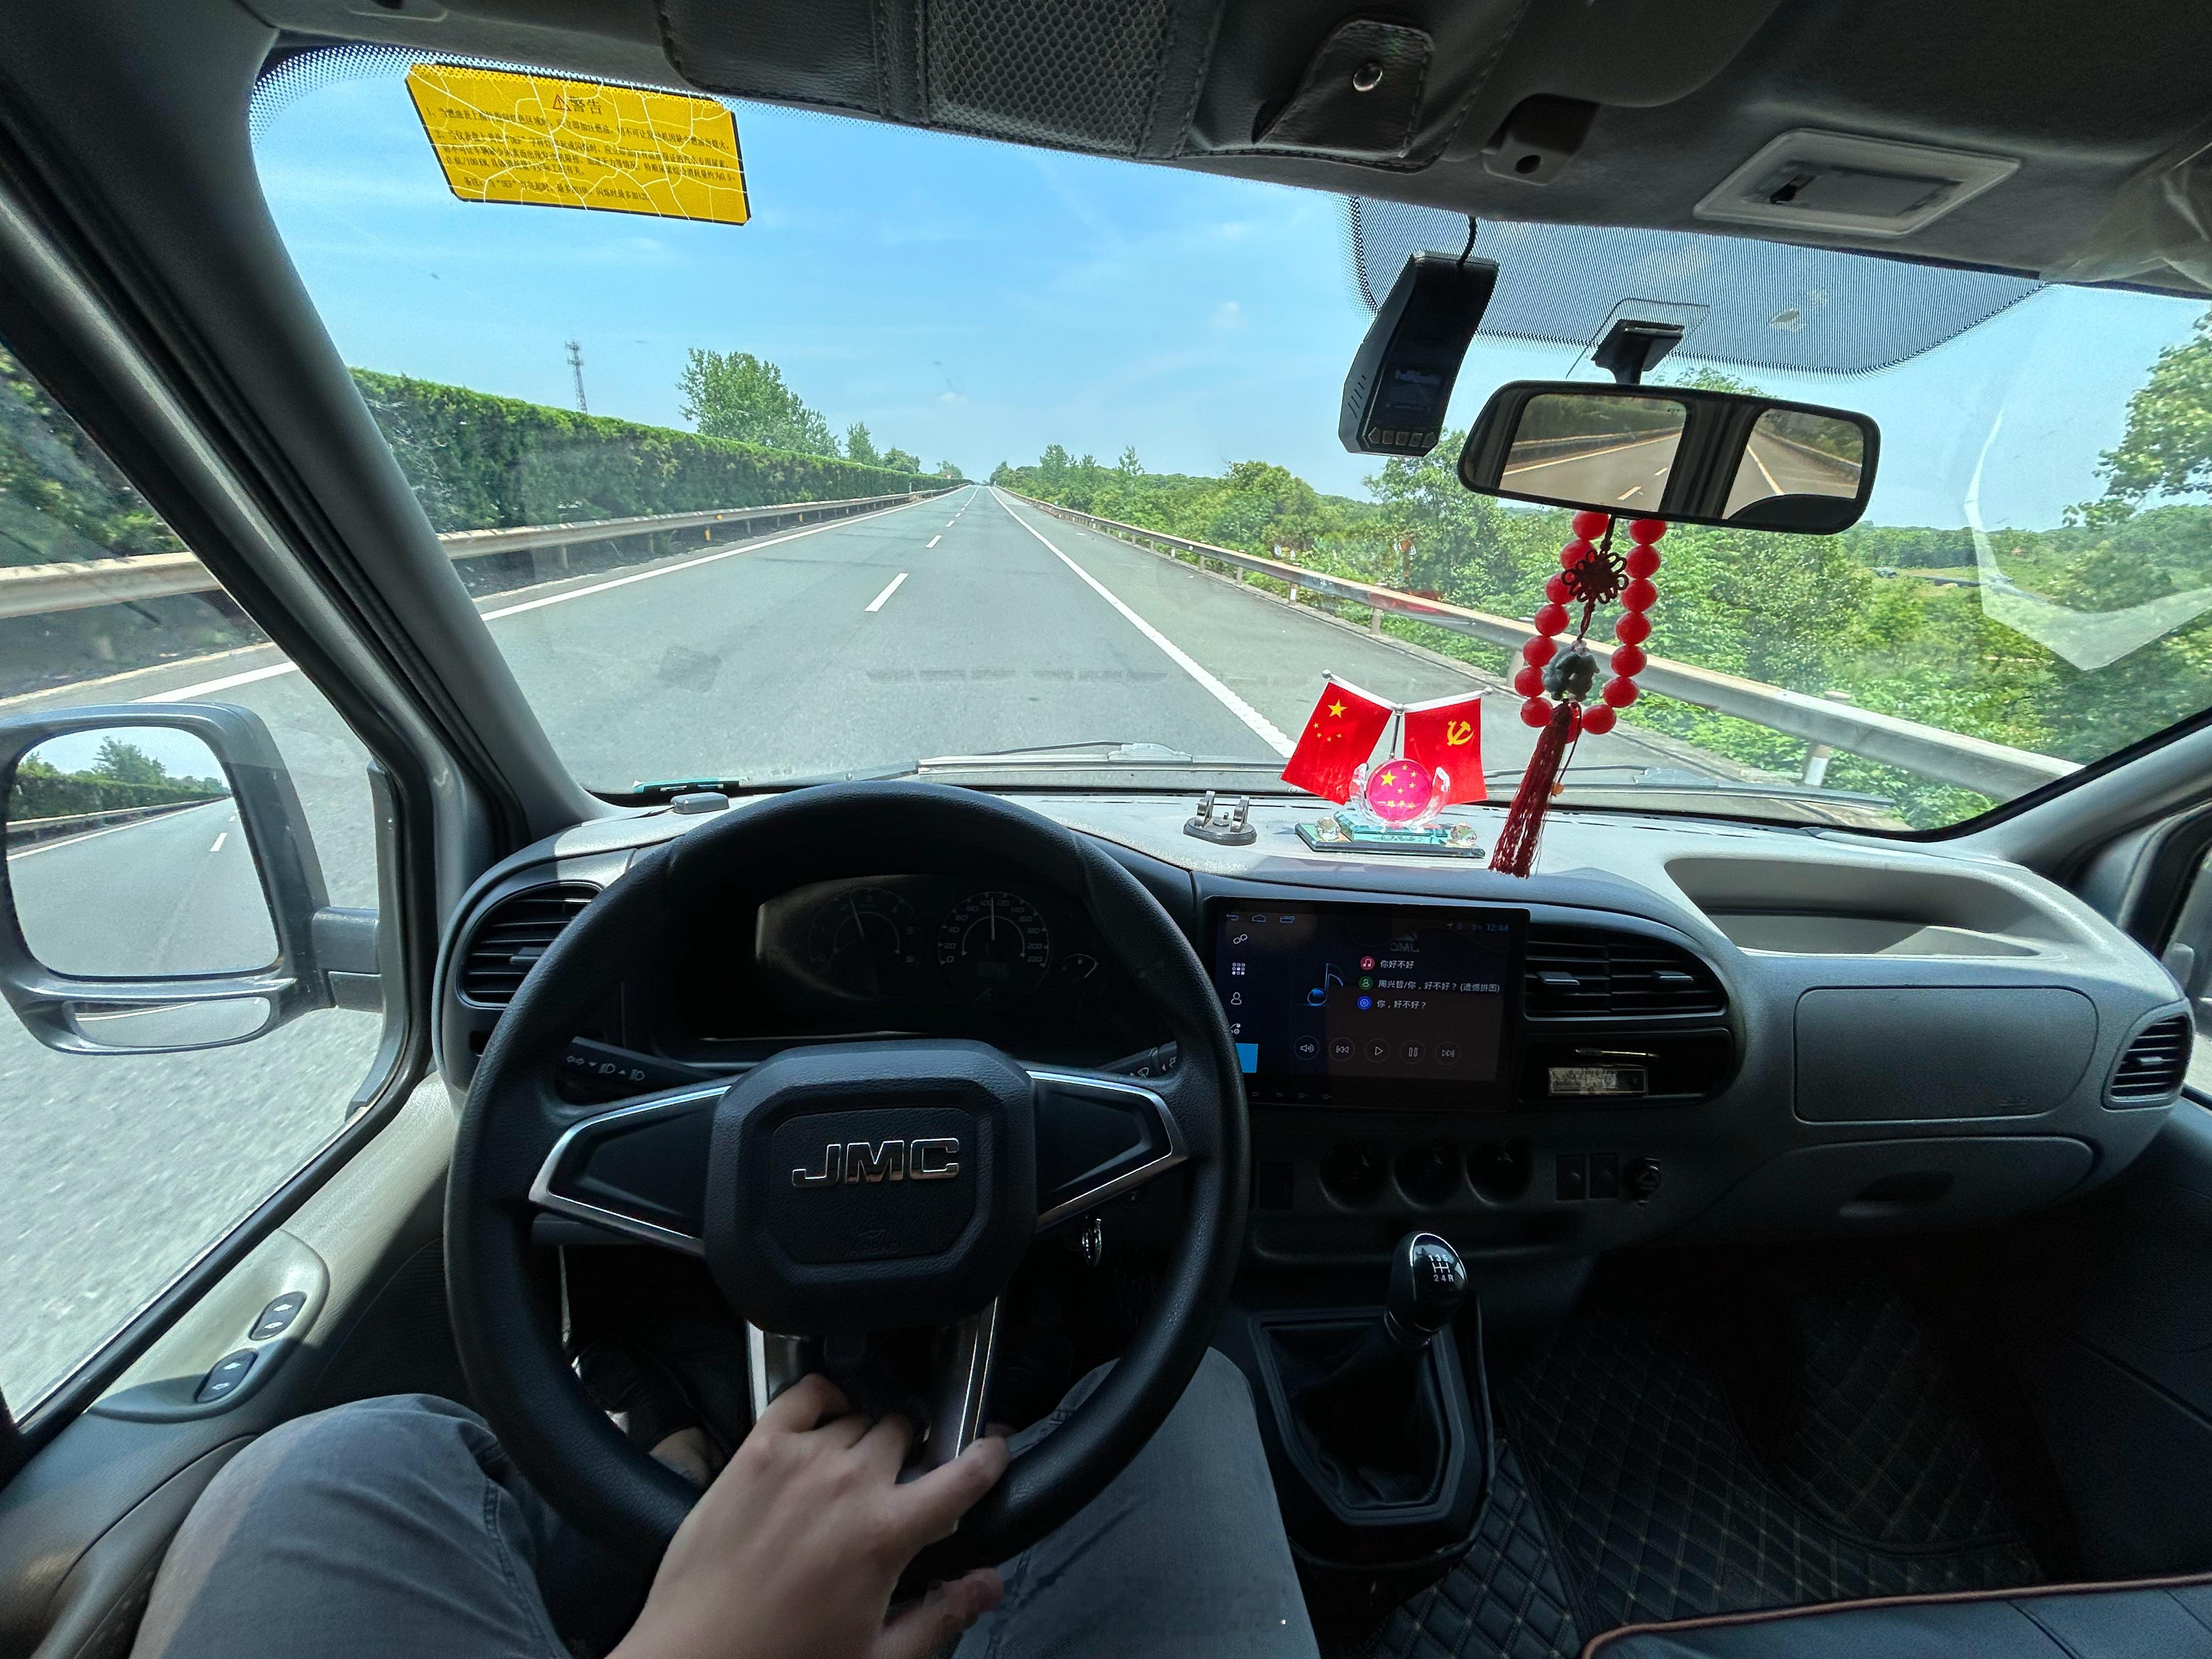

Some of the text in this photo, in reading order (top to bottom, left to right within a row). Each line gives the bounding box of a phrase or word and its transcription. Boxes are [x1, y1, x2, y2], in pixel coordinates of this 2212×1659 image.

[568, 95, 603, 115] 警告
[946, 955, 955, 963] 0
[1380, 960, 1415, 969] 你好不好
[1376, 1000, 1427, 1009] 你，好不好？
[791, 1137, 961, 1188] JMC
[1434, 1274, 1454, 1282] 2 4 R
